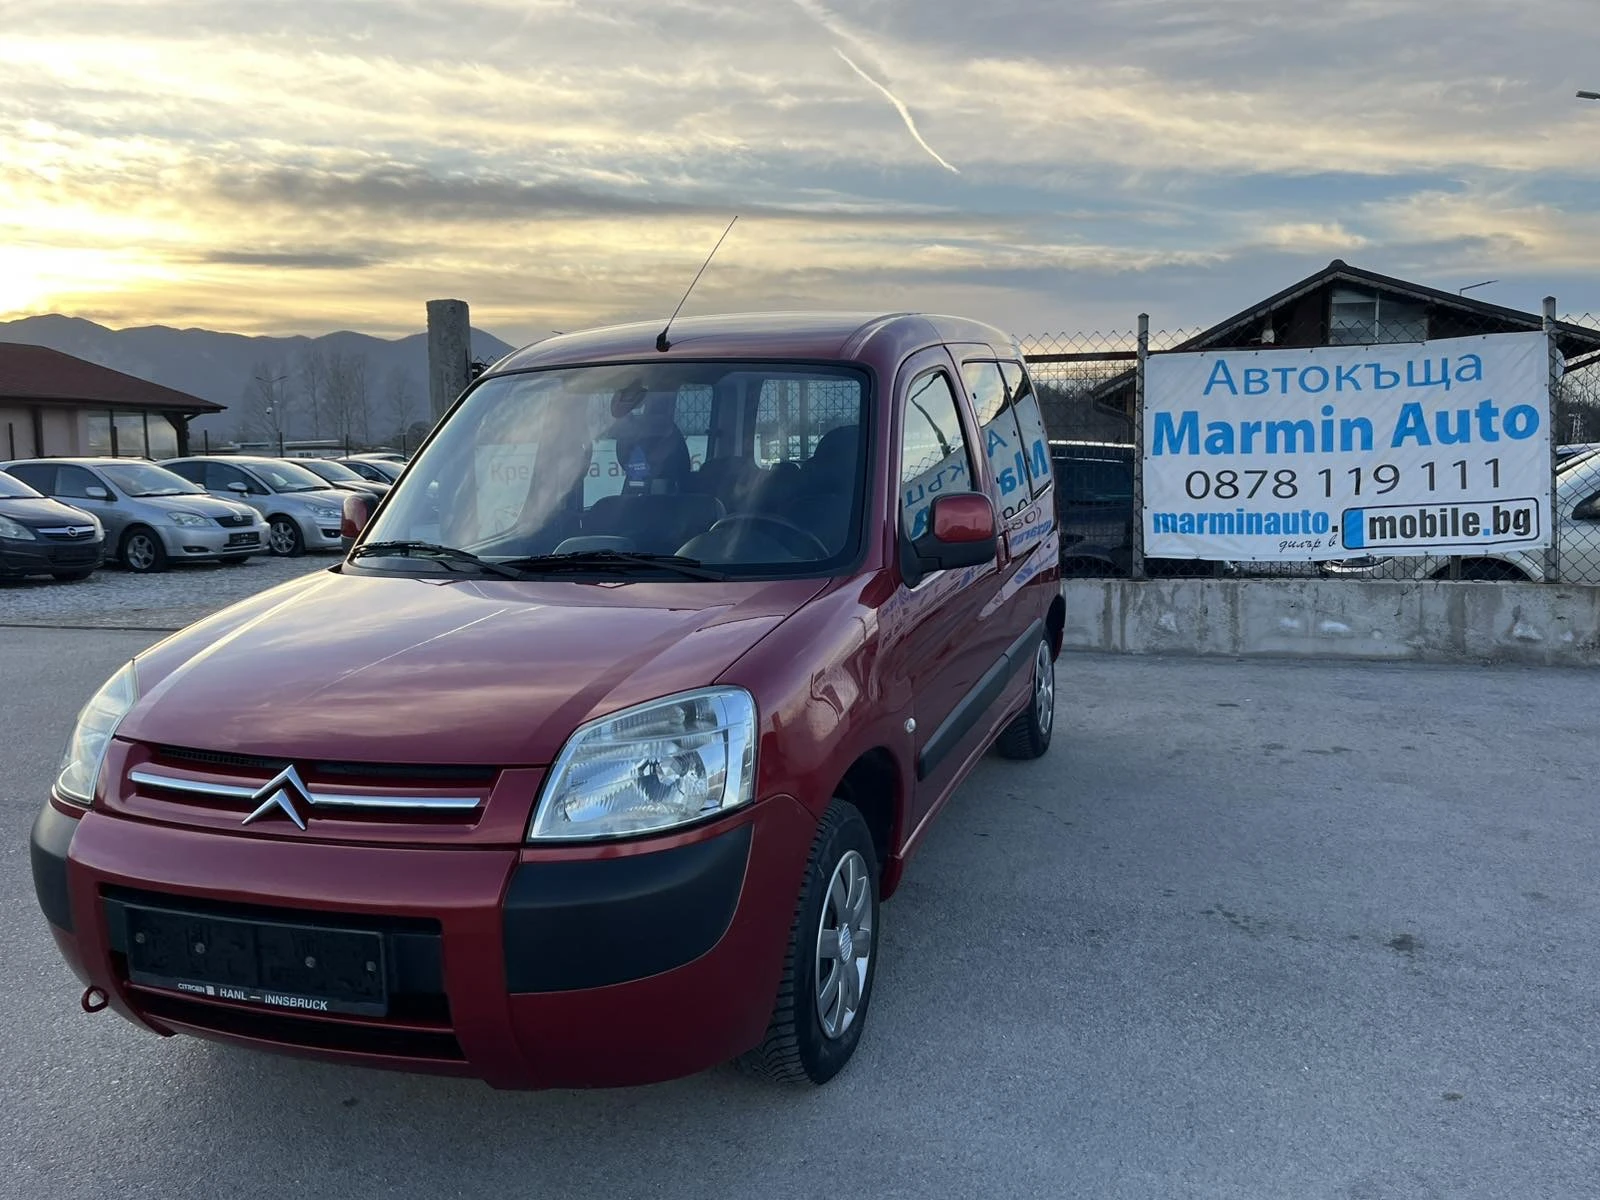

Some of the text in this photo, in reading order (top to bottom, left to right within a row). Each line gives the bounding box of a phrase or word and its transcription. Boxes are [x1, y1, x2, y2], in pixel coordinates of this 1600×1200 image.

[1203, 353, 1482, 396] Автокъща
[1151, 398, 1540, 456] Marmin Auto
[1185, 457, 1501, 499] 0878 119 111
[1369, 505, 1531, 540] mobile.bg
[220, 988, 248, 1000] HANL
[264, 994, 329, 1011] INNSBRUCK
